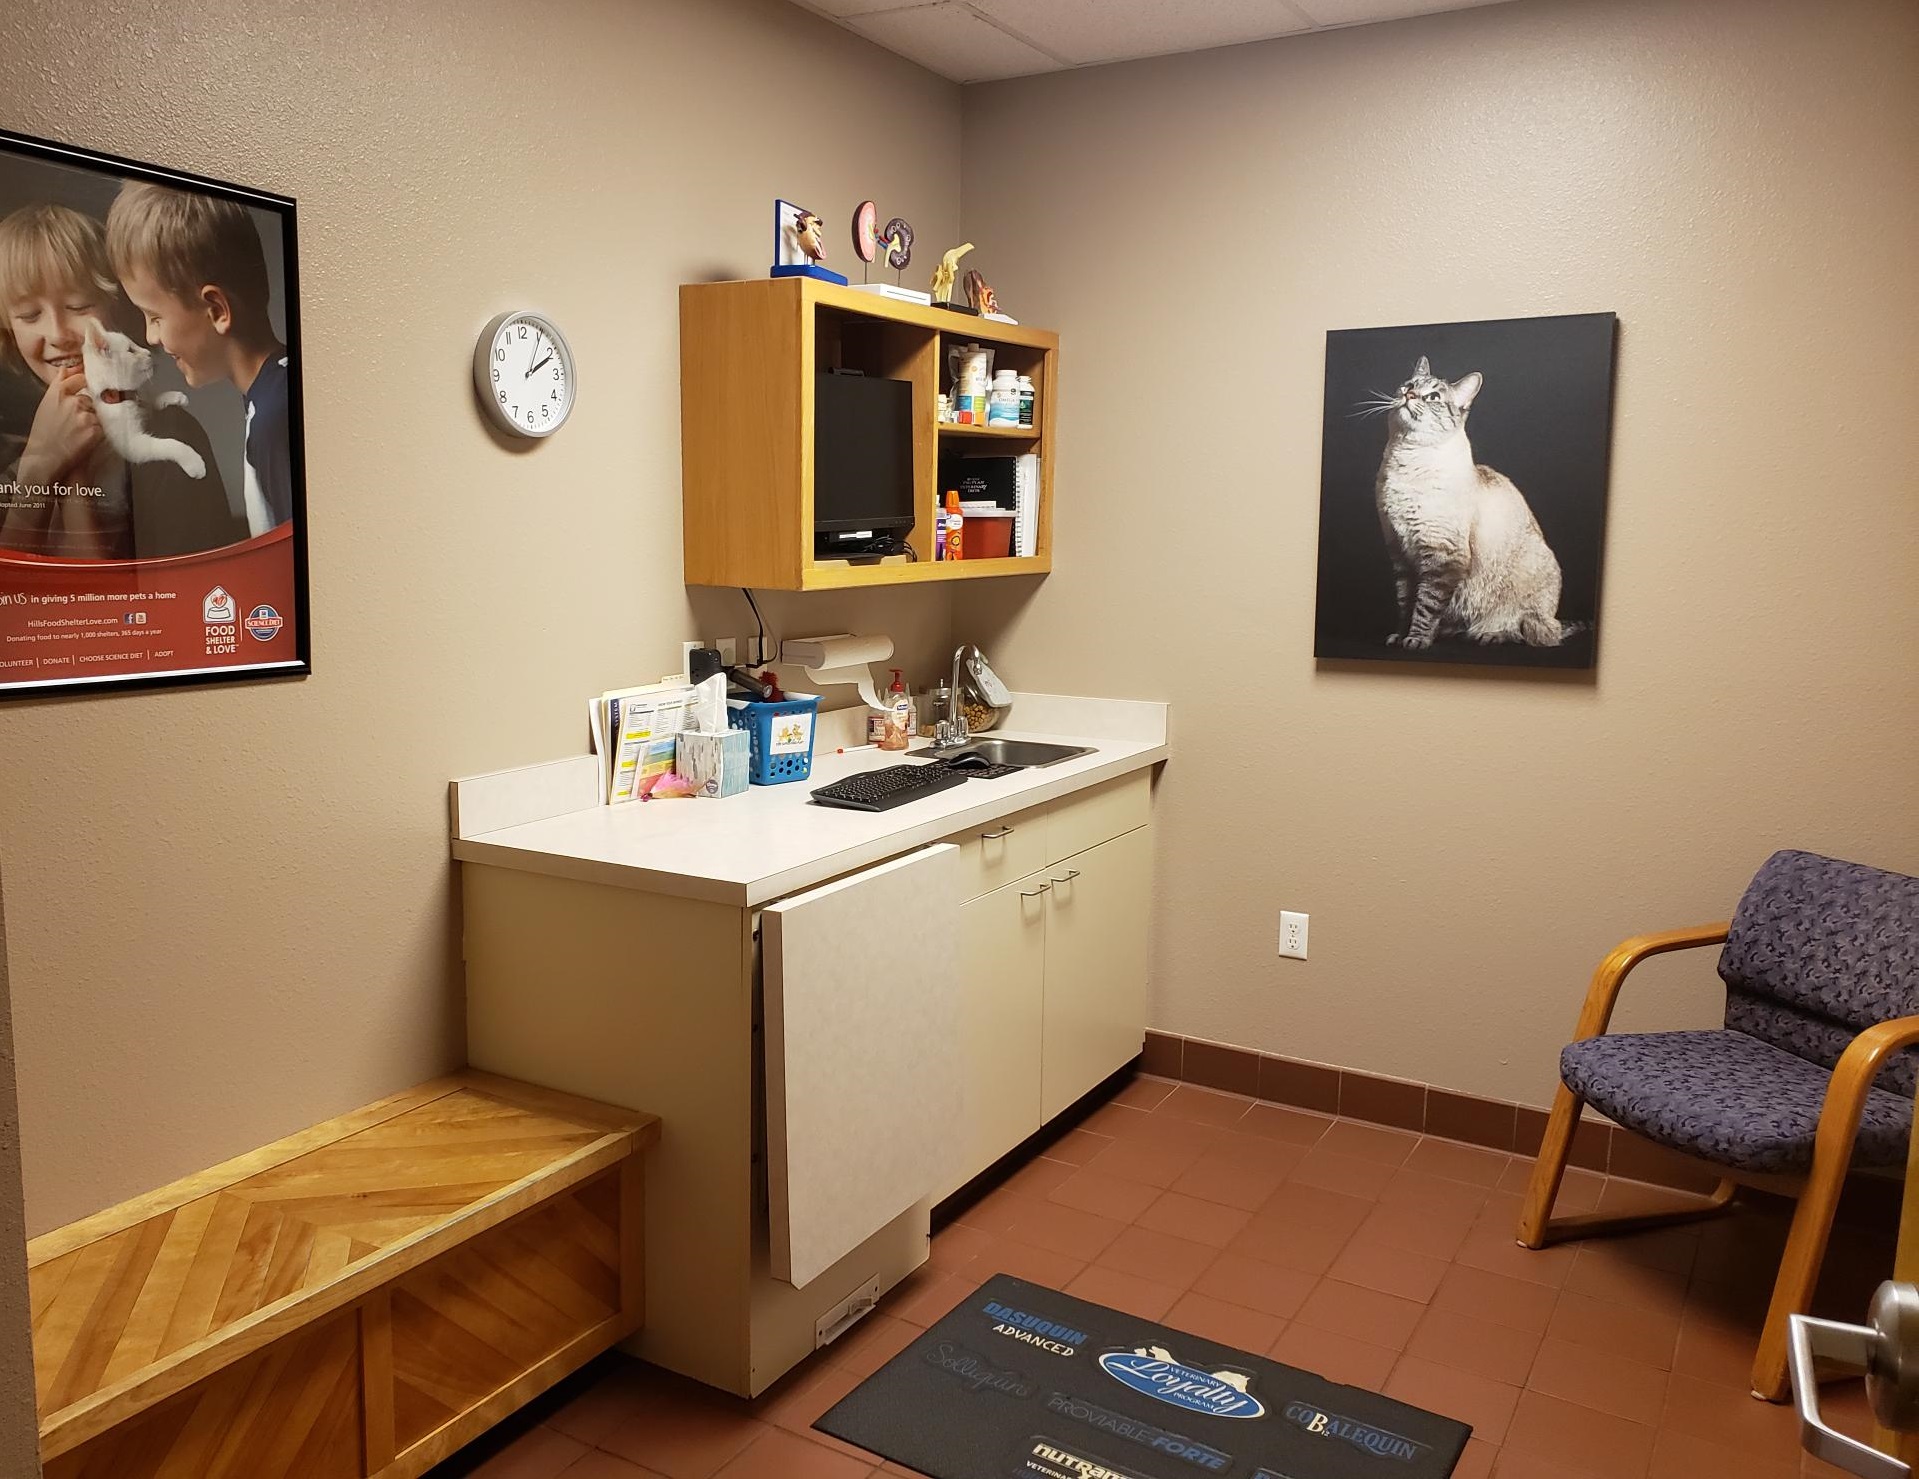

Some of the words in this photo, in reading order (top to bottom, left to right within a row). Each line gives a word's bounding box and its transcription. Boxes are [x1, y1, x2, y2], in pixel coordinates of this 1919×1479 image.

[505, 331, 512, 346] 11
[517, 326, 528, 340] 12
[494, 348, 506, 362] 10
[546, 347, 554, 360] 2
[493, 369, 500, 382] 9
[553, 368, 560, 381] 3
[500, 390, 507, 404] 8
[551, 389, 558, 402] 4
[512, 405, 519, 419] 7
[527, 411, 534, 424] 6
[541, 405, 549, 417] 5
[24, 485, 50, 498] you
[53, 482, 73, 496] for
[76, 483, 106, 497] love.
[31, 594, 39, 603] in
[42, 594, 68, 605] giving
[70, 594, 76, 602] 5
[78, 593, 105, 602] million
[107, 593, 128, 601] more
[130, 593, 147, 602] pets
[155, 591, 177, 599] home
[28, 617, 118, 628] HillsFoodShelterLove.com
[61, 632, 80, 640] nearly
[81, 631, 96, 639] 1,000
[97, 630, 121, 638] shelters,
[205, 625, 235, 637] FOOD
[205, 635, 235, 645] SHELTER
[154, 650, 174, 658] ADOPT
[205, 646, 212, 655] &
[213, 644, 236, 654] LOVE
[43, 656, 70, 665] DONATE
[79, 655, 104, 663] CHOOSE
[105, 653, 129, 661] SCIENCE
[130, 652, 143, 660] DIET
[982, 1301, 1088, 1346] DASUQUIN
[993, 1323, 1075, 1358] ADVANCED
[1169, 1366, 1222, 1388] VETERINARY
[1105, 1359, 1249, 1414] Loyalty
[1173, 1392, 1215, 1411] PROGRAM
